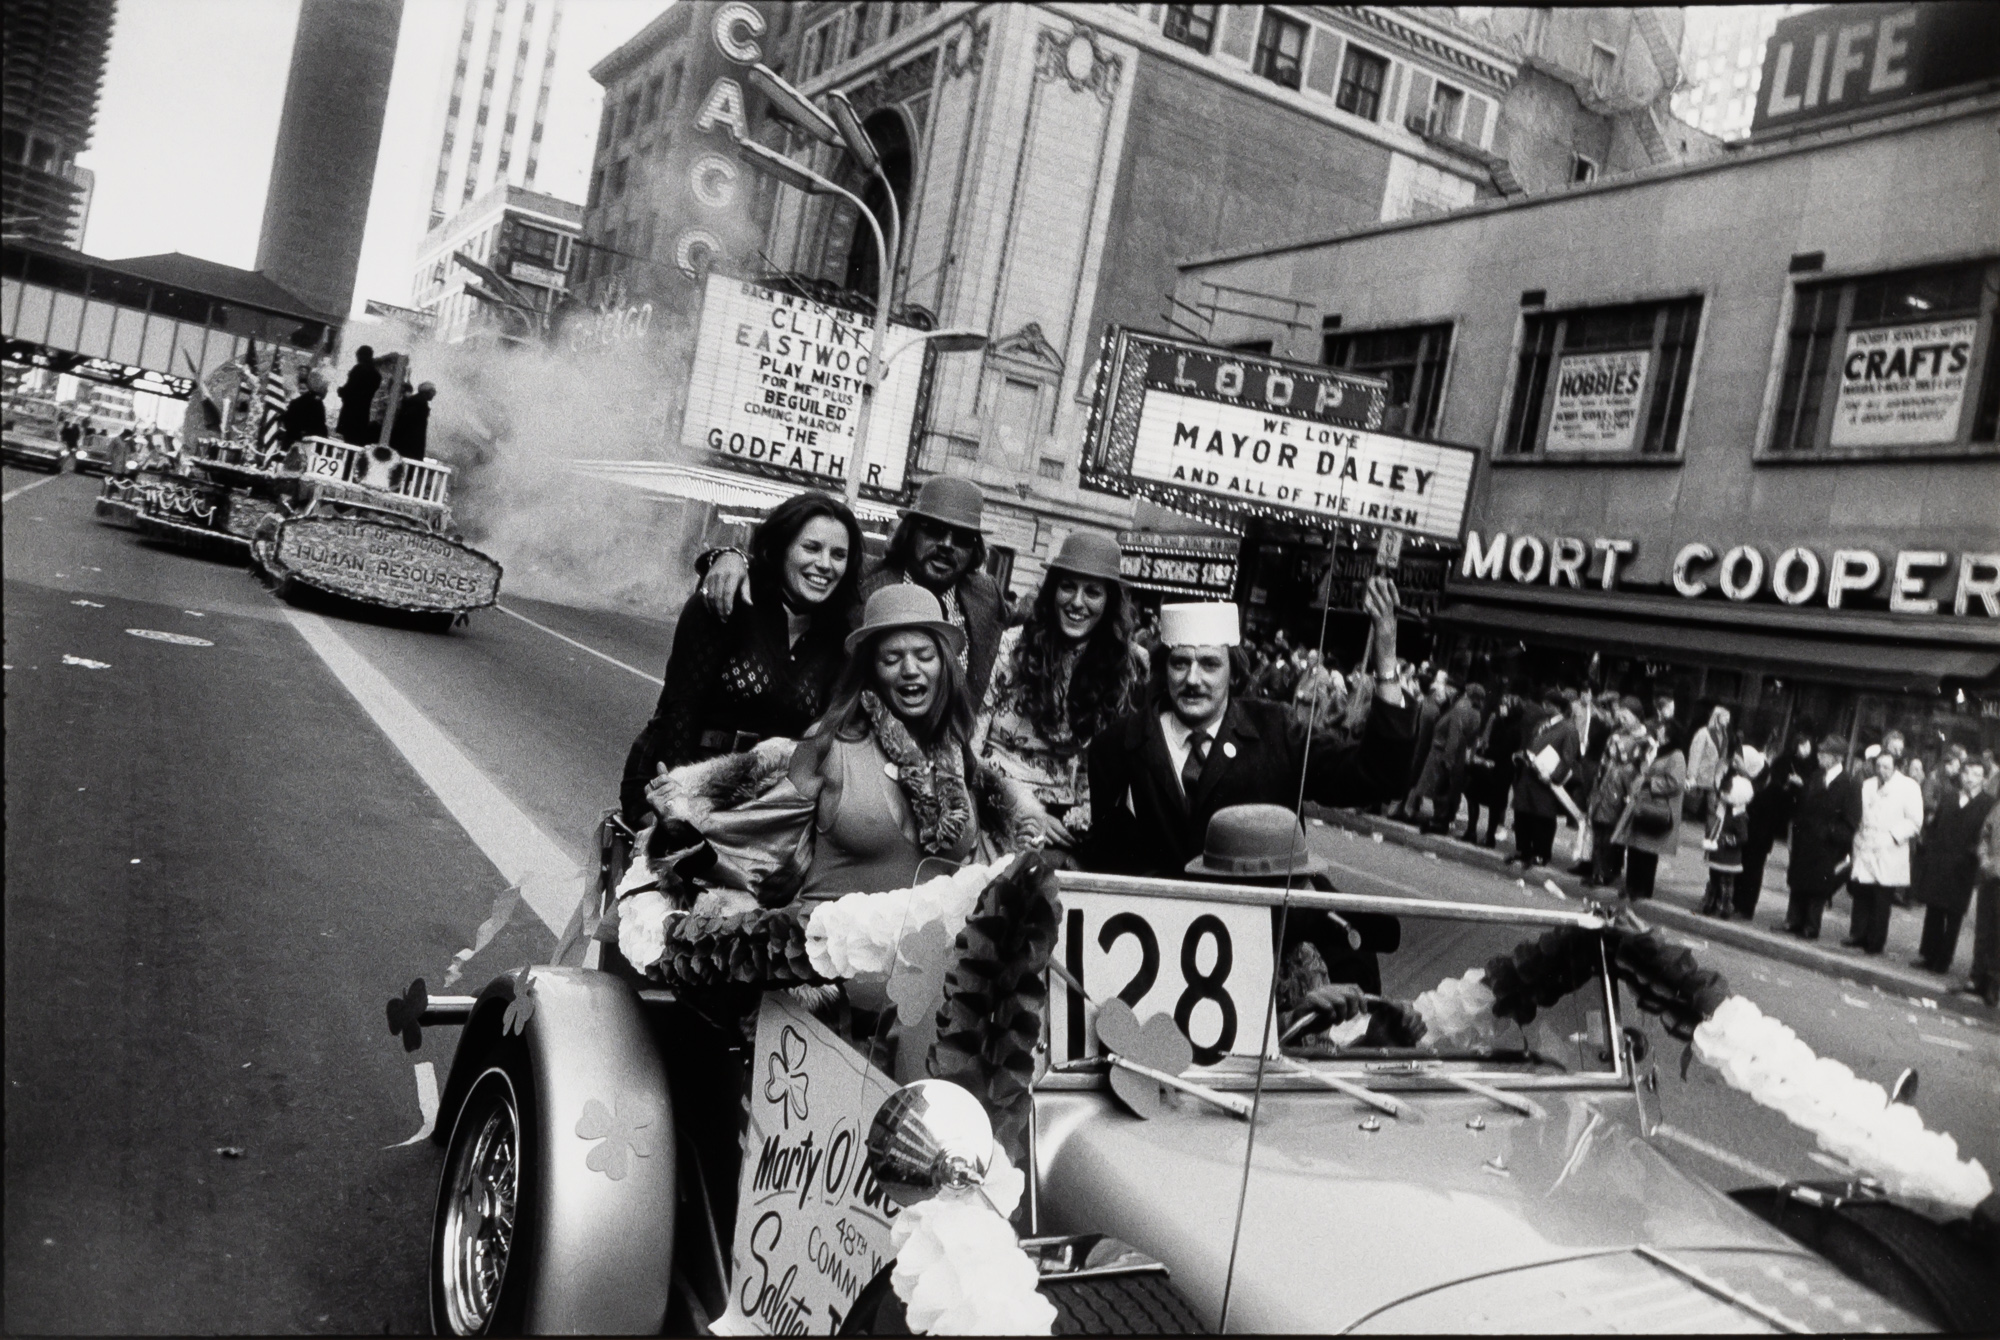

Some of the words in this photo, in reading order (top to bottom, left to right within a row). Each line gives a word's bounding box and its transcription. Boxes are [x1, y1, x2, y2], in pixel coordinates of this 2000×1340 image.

[1767, 8, 1916, 117] LIFE
[771, 308, 865, 349] CLINT
[862, 317, 892, 334] BET
[760, 355, 803, 378] PLAY
[811, 369, 862, 393] MISTY
[1844, 340, 1970, 380] CRAFTS
[762, 374, 788, 389] FOR
[823, 389, 853, 405] PLUS
[1174, 355, 1343, 414] LOOP
[1560, 370, 1641, 397] HOBBIES
[744, 402, 793, 422] COMING
[798, 415, 841, 434] MARCH
[764, 390, 847, 420] BEGUILED
[786, 426, 819, 446] THE
[1263, 418, 1289, 436] WE
[1306, 428, 1360, 449] LOVE
[312, 457, 339, 477] 129
[708, 428, 882, 485] GODFATHR
[1173, 422, 1298, 469] MAYOR
[1316, 451, 1435, 496] DALEY
[1173, 466, 1219, 487] AND
[1228, 476, 1266, 500] ALL
[1277, 486, 1302, 502] OF
[1314, 491, 1350, 512] THE
[1360, 502, 1419, 527] IRISH
[374, 529, 390, 541] OF
[296, 545, 365, 572] HUMAN
[377, 560, 479, 594] RESOURCES
[1462, 531, 1633, 591] MORT
[1672, 543, 2000, 618] COOPER
[1066, 907, 1238, 1067] 128
[753, 1131, 822, 1210] Marty
